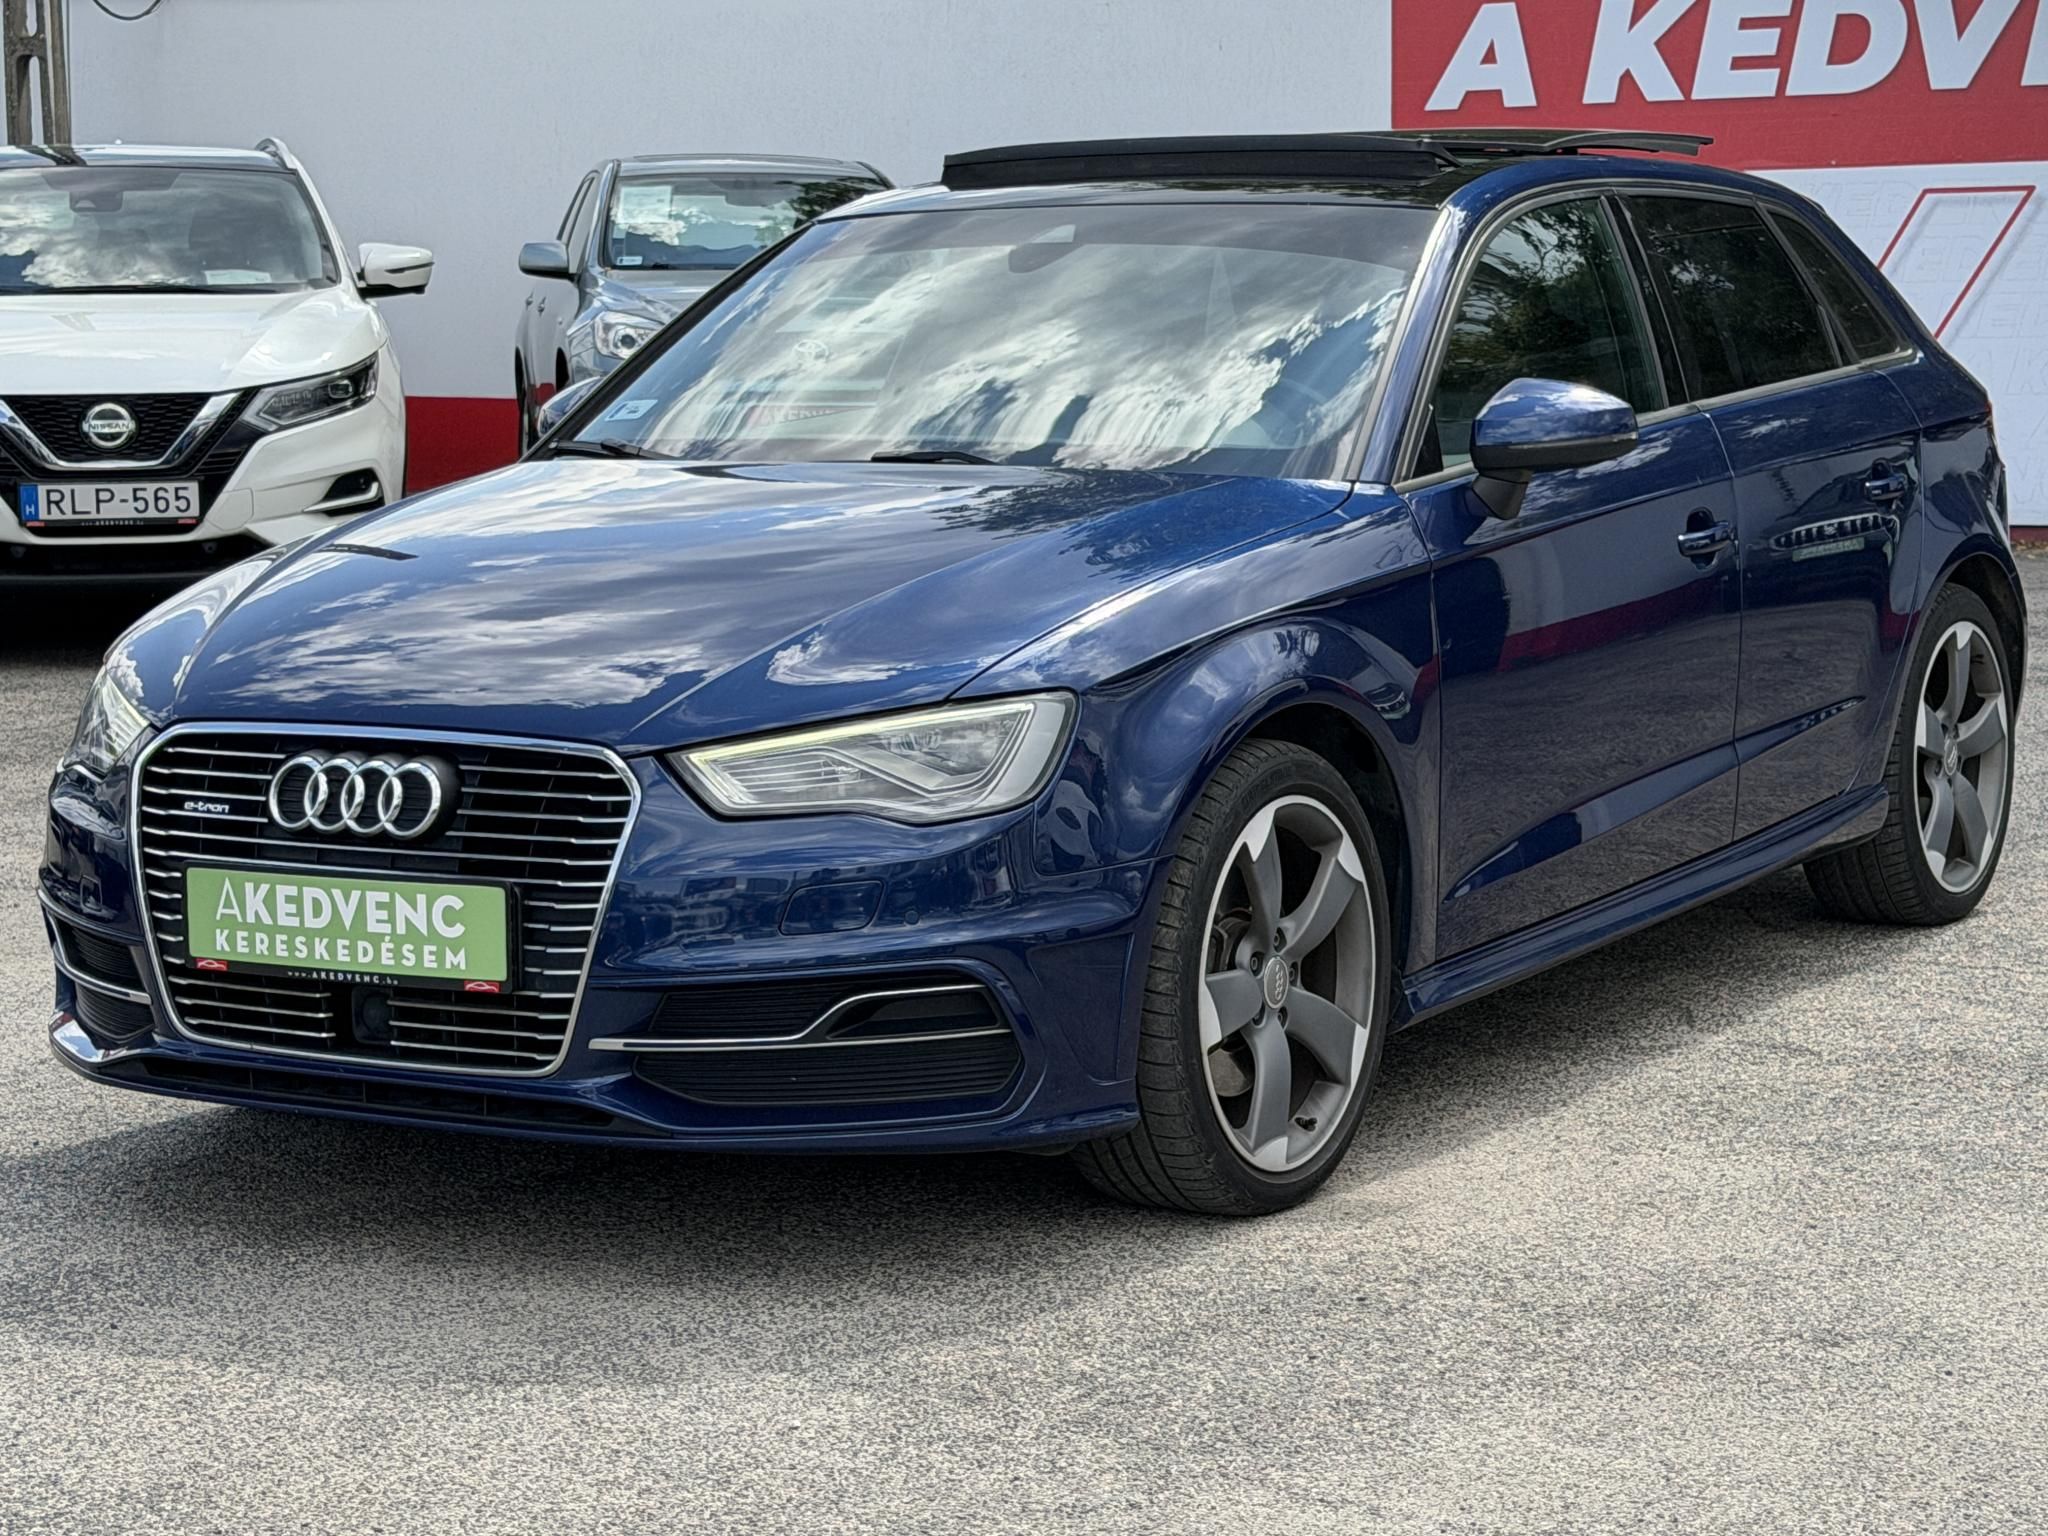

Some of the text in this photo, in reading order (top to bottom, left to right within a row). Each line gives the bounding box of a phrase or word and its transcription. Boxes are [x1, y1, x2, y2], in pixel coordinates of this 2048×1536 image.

[1424, 0, 2048, 111] A KEDV
[88, 421, 130, 431] NISSAN
[25, 486, 191, 516] H RLP-565
[184, 801, 230, 814] e-tron
[215, 928, 467, 971] KERESKEDÉSEM
